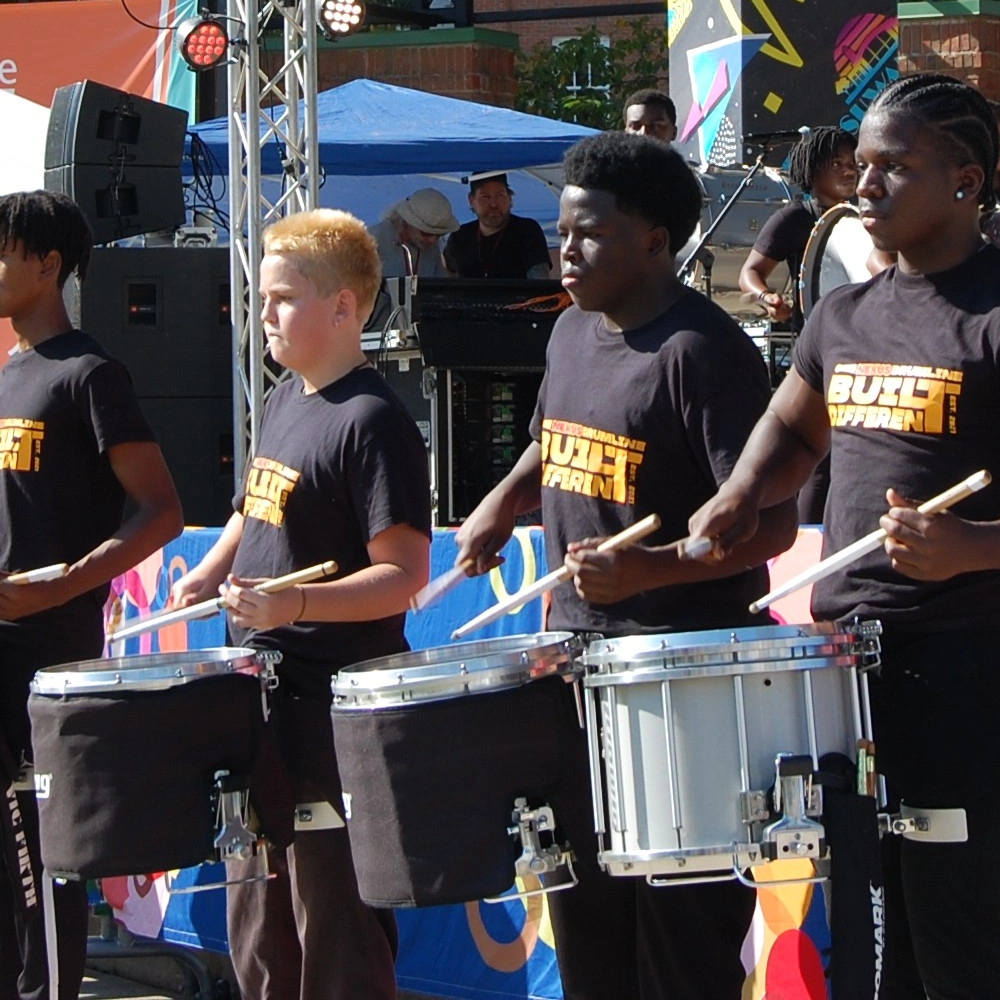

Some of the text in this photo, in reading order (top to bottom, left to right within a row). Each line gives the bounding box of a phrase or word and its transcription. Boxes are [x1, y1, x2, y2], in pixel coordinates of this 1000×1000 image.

[827, 374, 962, 434] BUILT
[6, 780, 37, 909] VIC FIRTH
